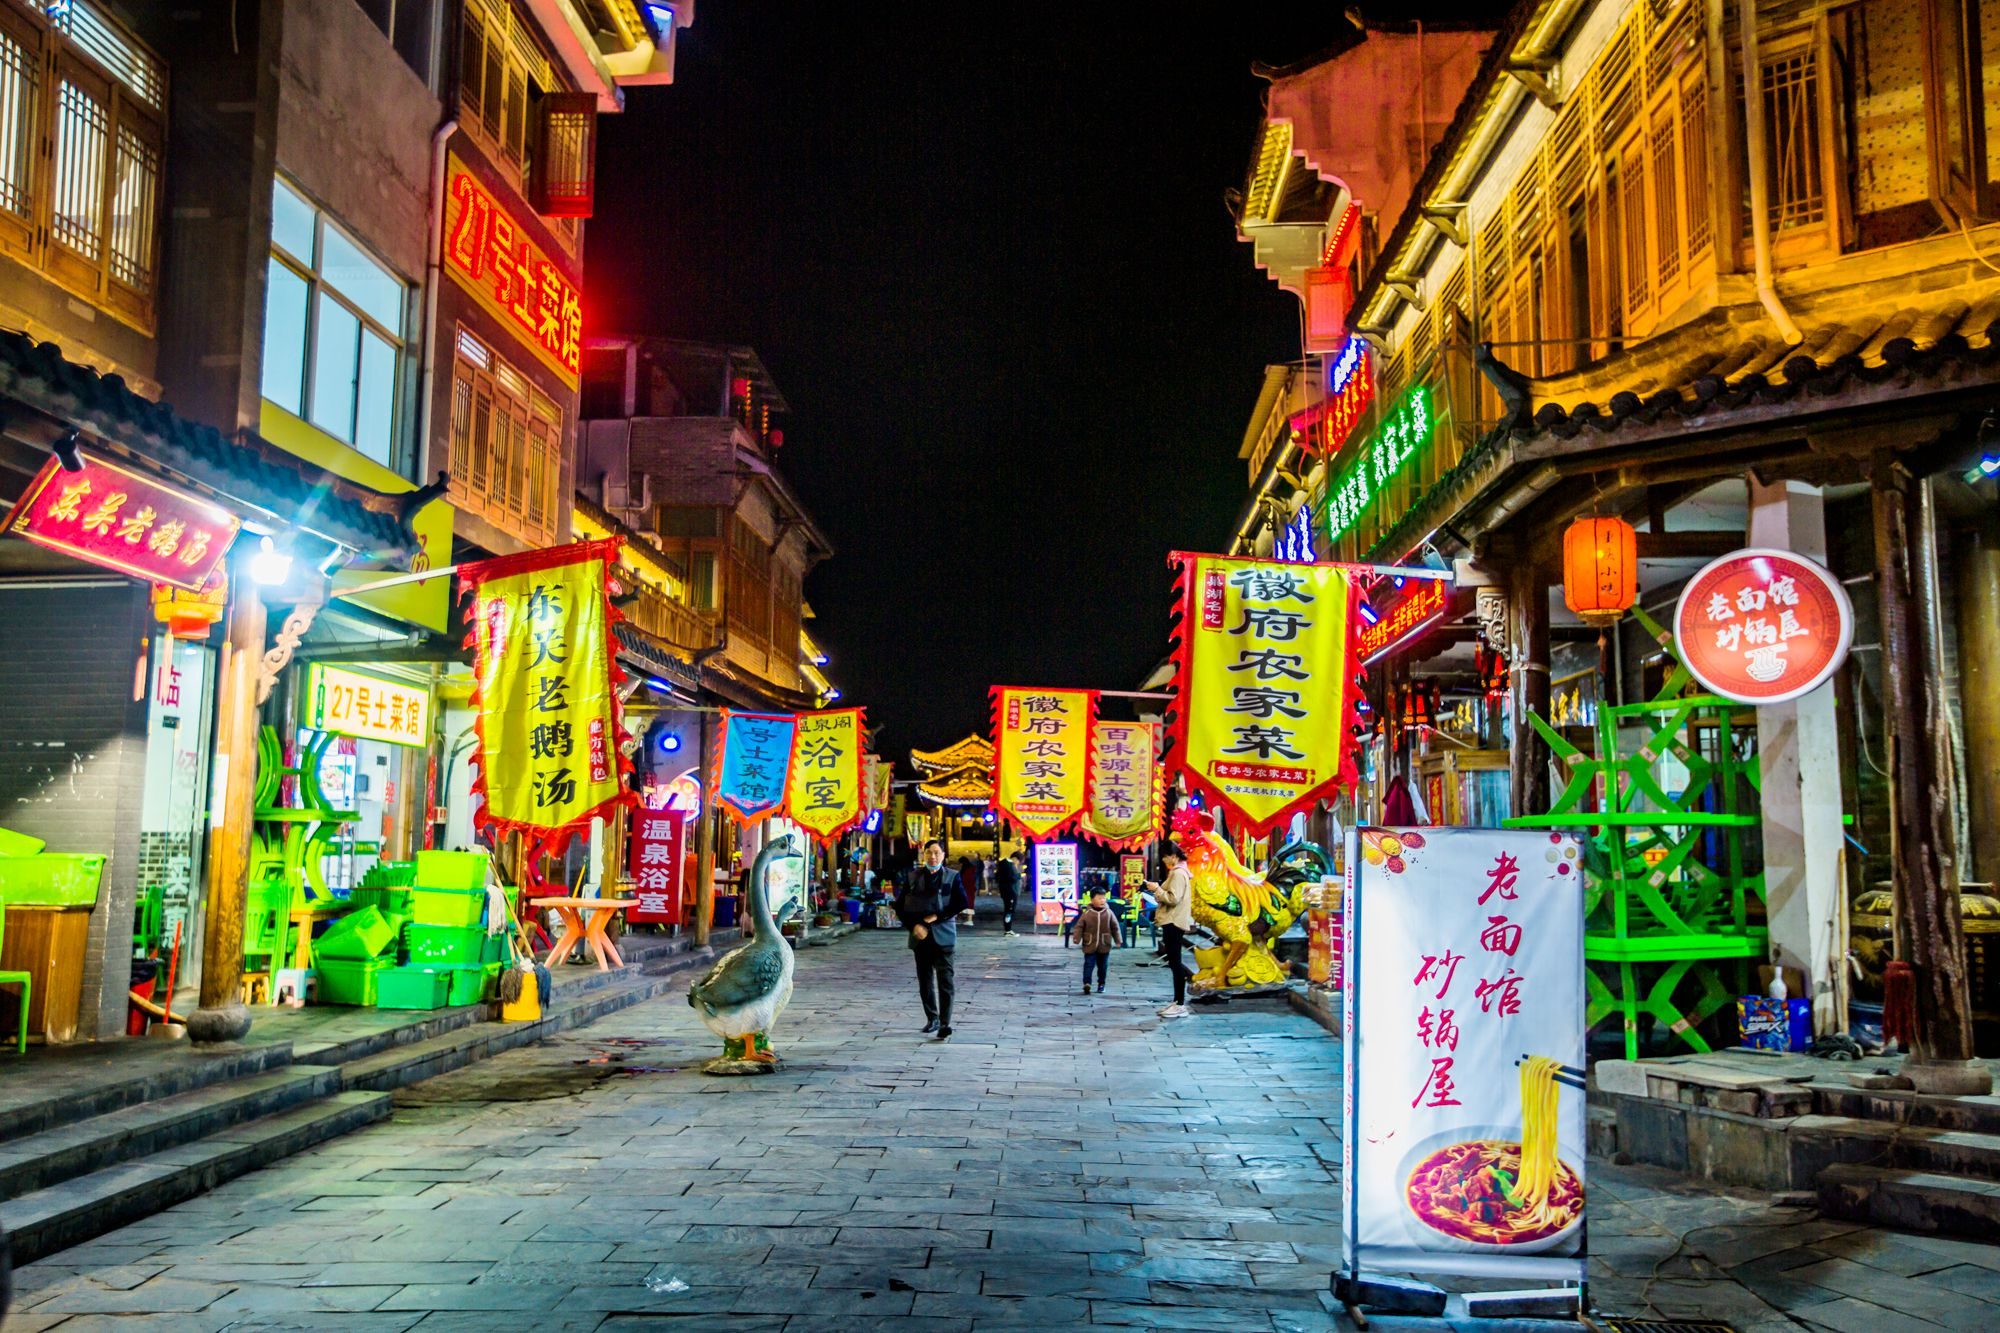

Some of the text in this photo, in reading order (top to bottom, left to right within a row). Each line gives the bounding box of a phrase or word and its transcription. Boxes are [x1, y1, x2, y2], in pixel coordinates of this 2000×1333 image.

[456, 176, 581, 375] 27号土菜馆
[48, 479, 212, 567] 东关老鹅汤
[1205, 575, 1224, 625] 巢湖名吃
[1705, 575, 1800, 621] 老面馆
[1715, 608, 1809, 652] 砂锅屋
[521, 584, 577, 808] 东关老鹅汤
[1222, 569, 1315, 761] 徽府农家菜
[331, 683, 420, 737] 27号土菜馆
[589, 719, 608, 782] 地方特色
[1020, 696, 1069, 801] 徽府农家菜
[735, 718, 777, 799] 号土菜馆
[801, 736, 846, 811] 浴室
[1099, 727, 1136, 819] 百味源土菜馆
[1216, 763, 1305, 782] 老字号农家土菜
[637, 818, 673, 914] 温泉浴室
[1474, 850, 1525, 1018] 老面馆
[1412, 949, 1466, 1109] 砂锅屋
